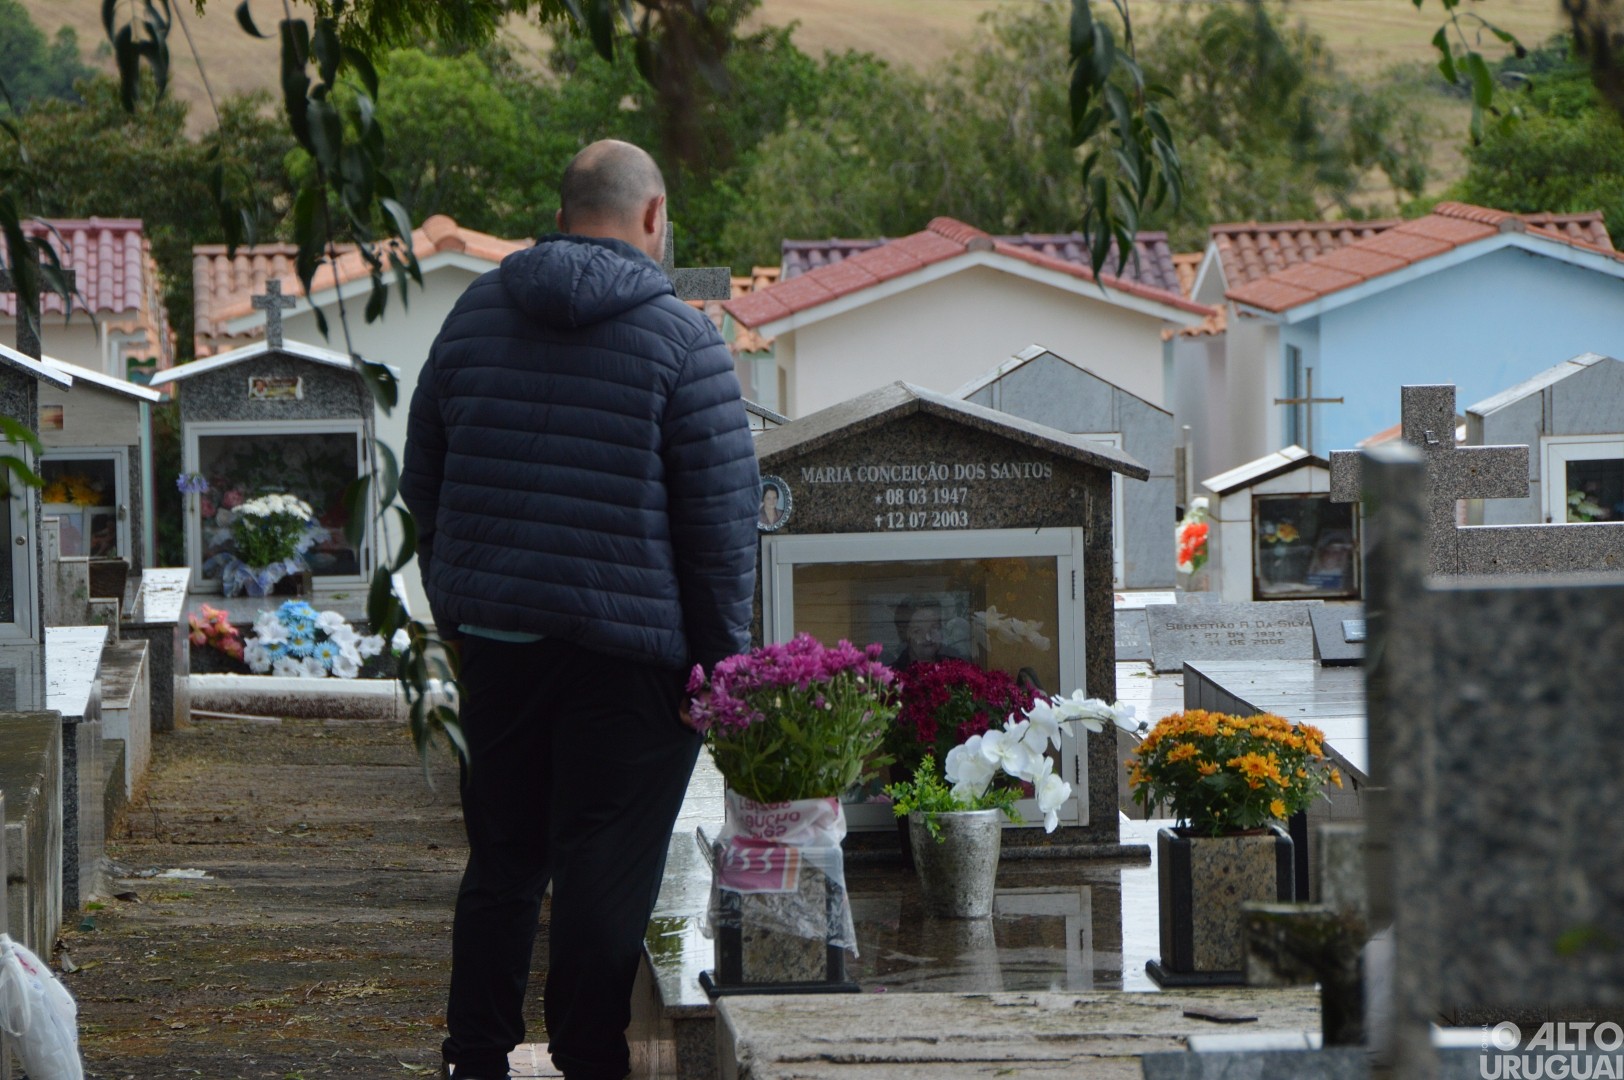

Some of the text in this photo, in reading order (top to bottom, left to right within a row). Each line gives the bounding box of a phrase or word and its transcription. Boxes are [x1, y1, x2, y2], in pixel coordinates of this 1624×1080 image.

[801, 462, 1053, 485] MARIA CONCEIÇÃO DOS SANTOS
[886, 487, 968, 505] 08 03 1947
[887, 510, 969, 529] 12 07 2003
